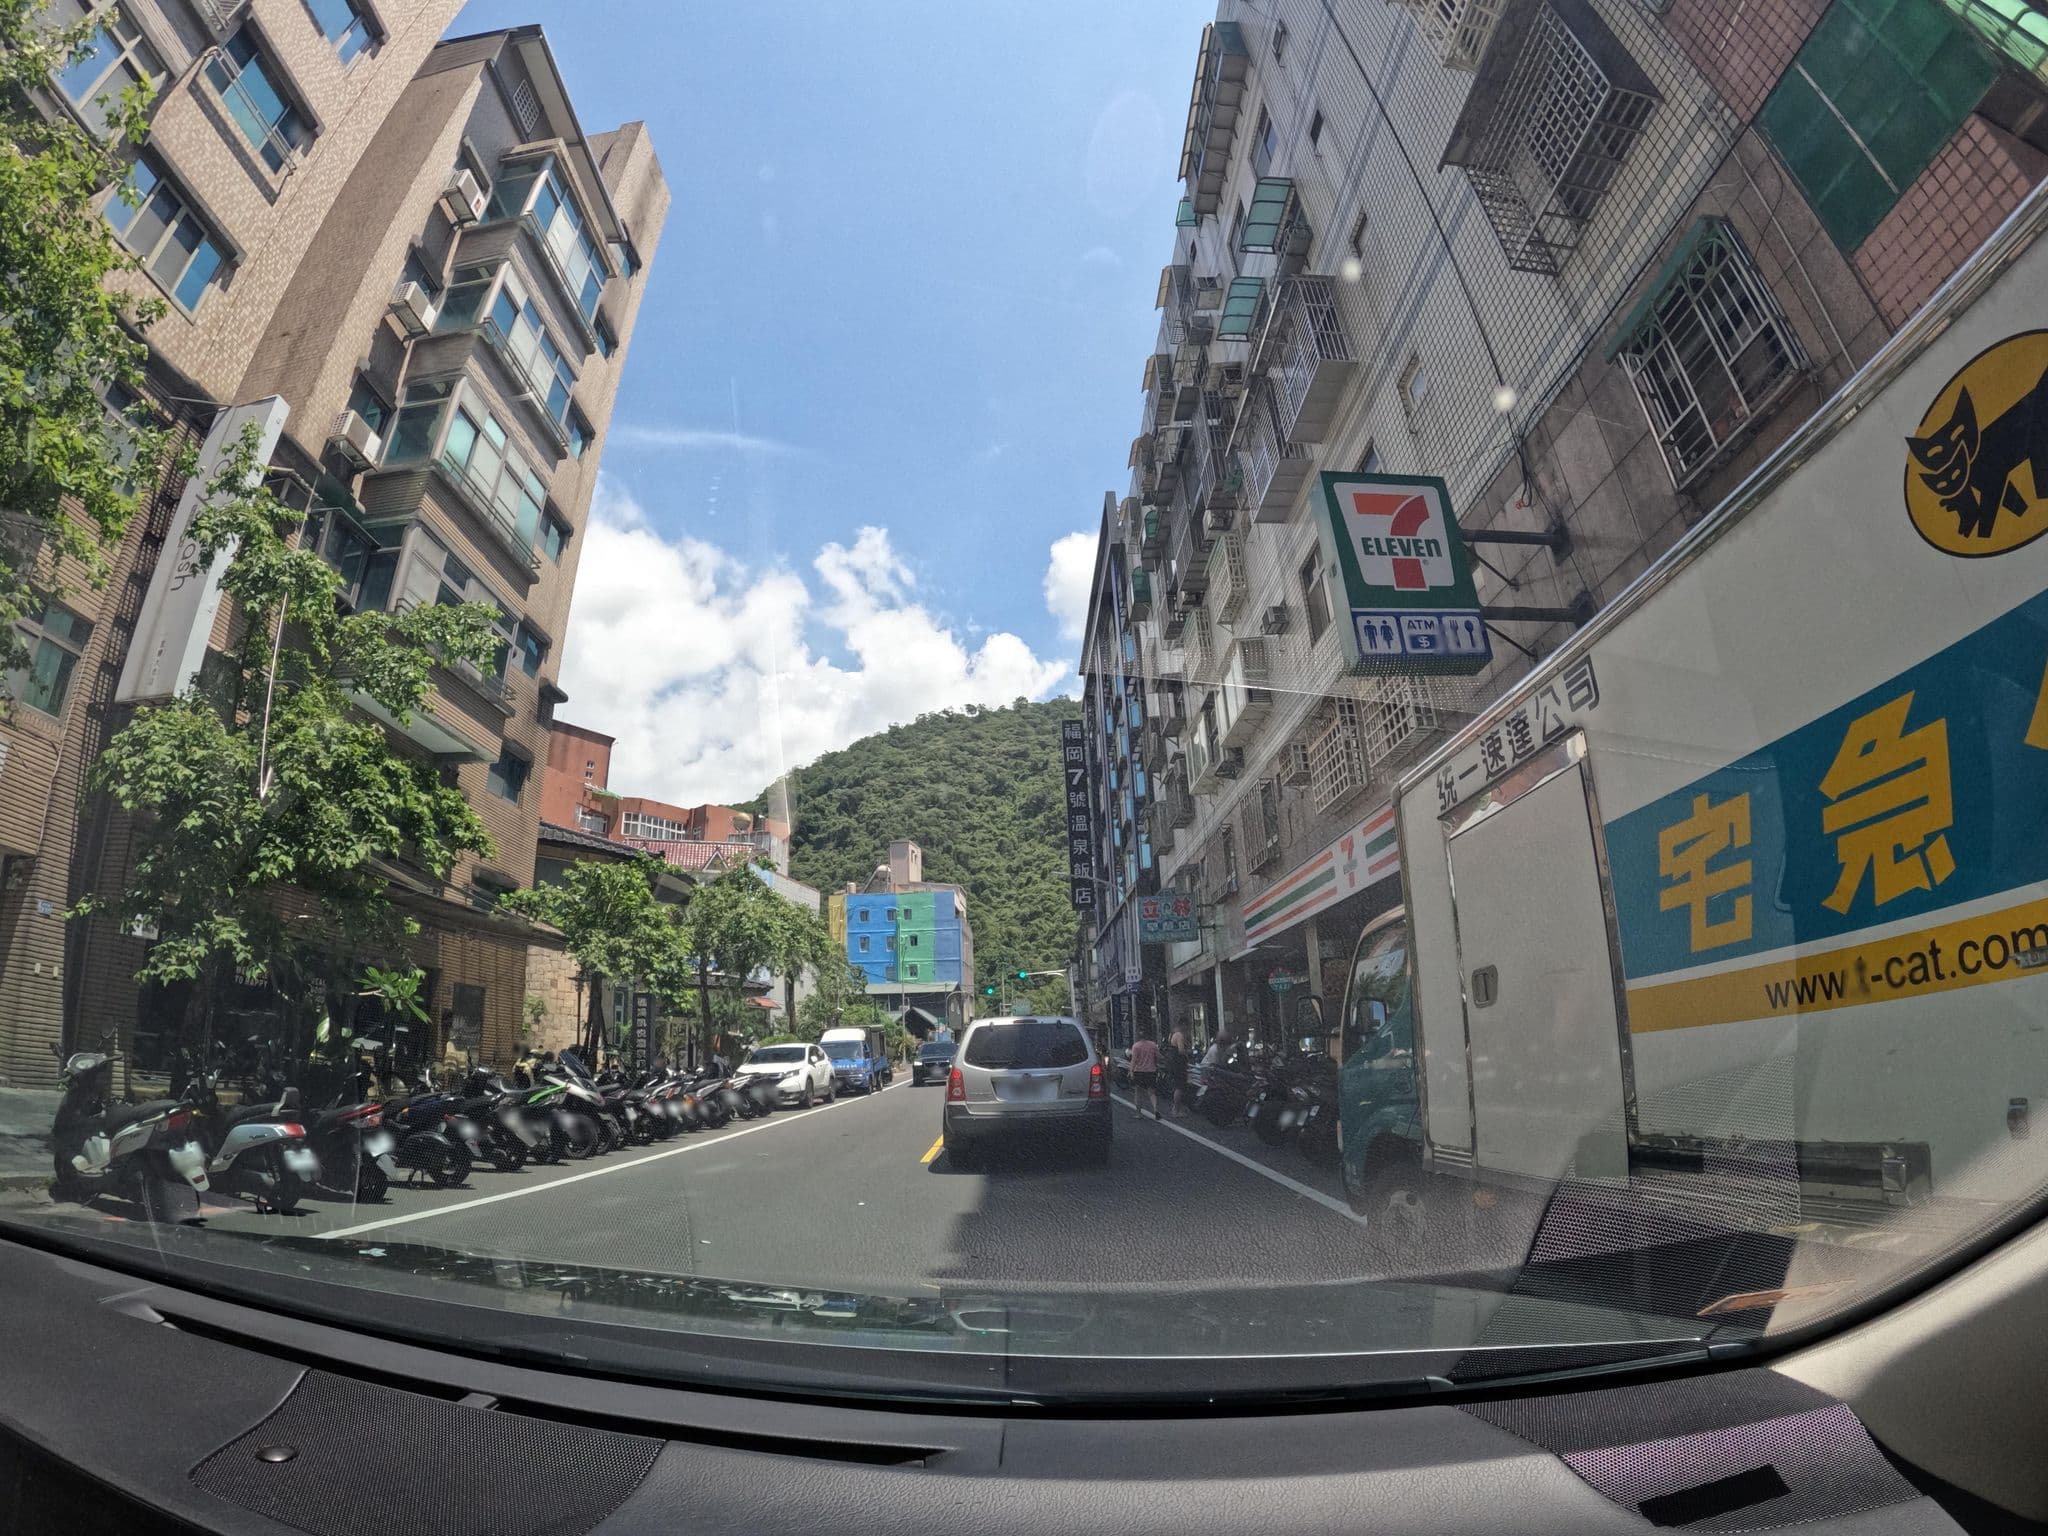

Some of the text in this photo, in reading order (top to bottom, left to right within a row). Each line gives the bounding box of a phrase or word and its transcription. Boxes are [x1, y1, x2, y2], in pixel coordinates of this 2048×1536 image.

[1353, 492, 1430, 589] 7
[1407, 619, 1435, 631] ATM
[1436, 655, 1600, 810] 統一速達公司
[1064, 723, 1092, 905] 福岡7號溫泉飯店
[1659, 661, 2048, 952] 宅急
[1765, 923, 2048, 1009] wwwt-cat.com
